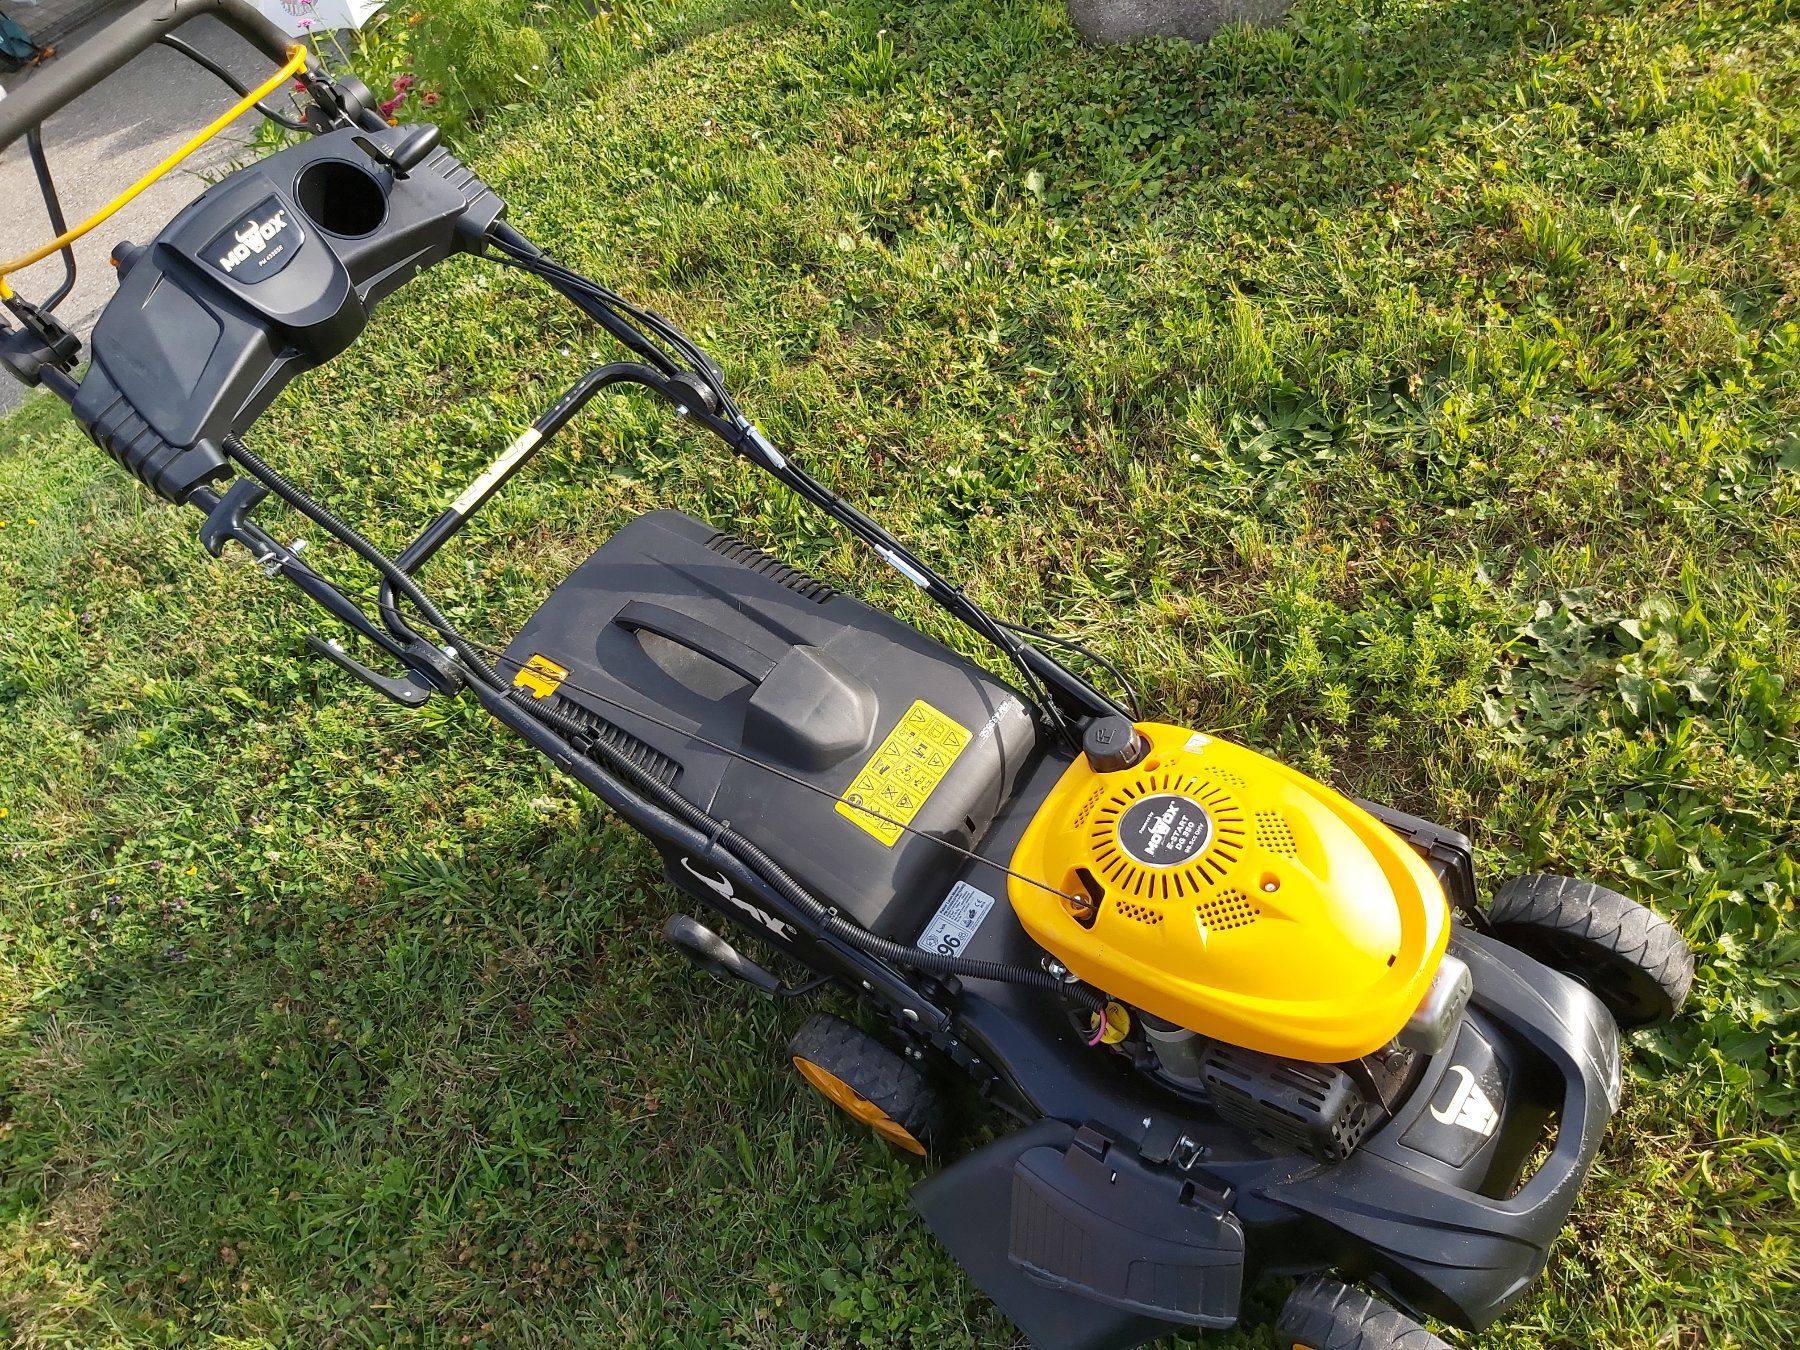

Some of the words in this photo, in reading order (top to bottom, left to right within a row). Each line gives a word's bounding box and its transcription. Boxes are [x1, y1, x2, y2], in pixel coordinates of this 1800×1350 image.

[1166, 815, 1189, 850] E-START
[1175, 836, 1186, 850] DG
[937, 934, 960, 957] 96
